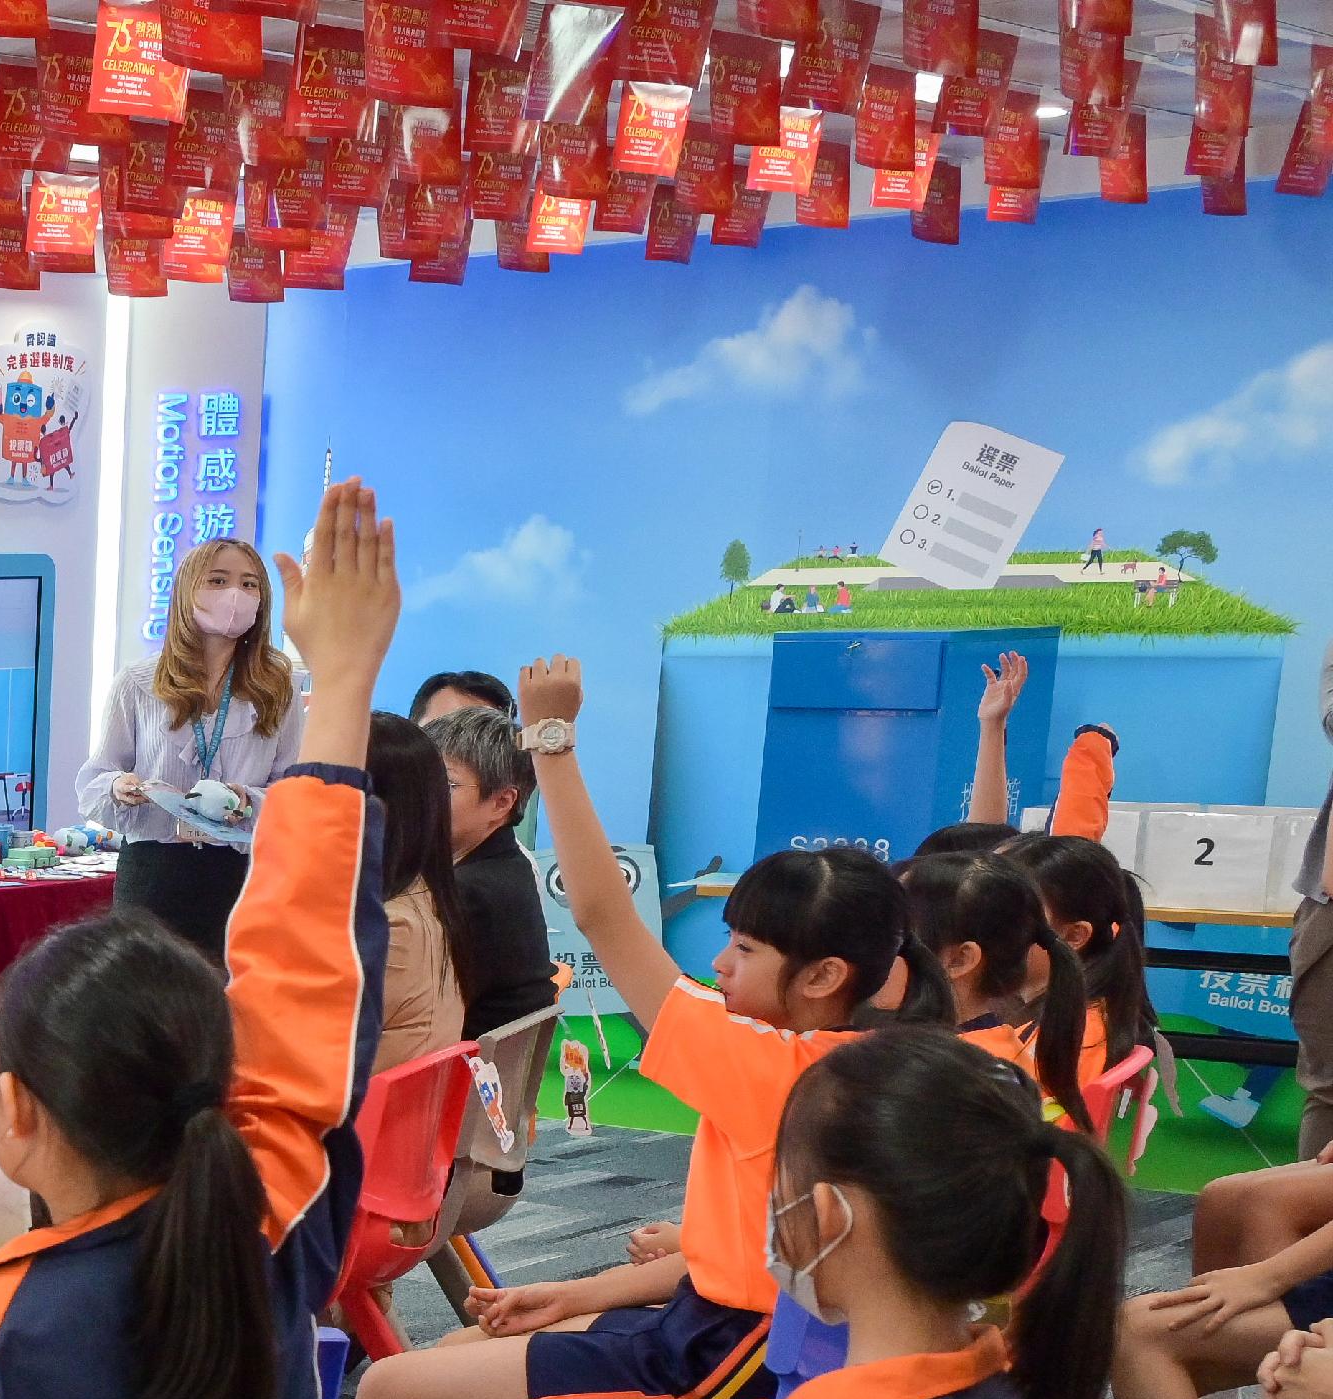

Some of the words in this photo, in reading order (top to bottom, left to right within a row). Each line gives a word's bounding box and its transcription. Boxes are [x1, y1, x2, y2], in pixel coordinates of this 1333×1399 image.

[106, 19, 133, 56] 75
[103, 59, 155, 75] CELEBRATING
[7, 352, 74, 372] 完善選舉制度
[154, 393, 188, 503] Motion
[977, 444, 1019, 474] 選票
[962, 461, 987, 478] Ballot
[989, 472, 1015, 488] Paper
[947, 488, 955, 501] 1.
[931, 512, 941, 526] 2.
[918, 538, 928, 551] 3.
[1194, 838, 1215, 865] 2
[600, 978, 613, 988] Bo
[1208, 993, 1254, 1010] Ballot
[1258, 1000, 1289, 1016] Box
